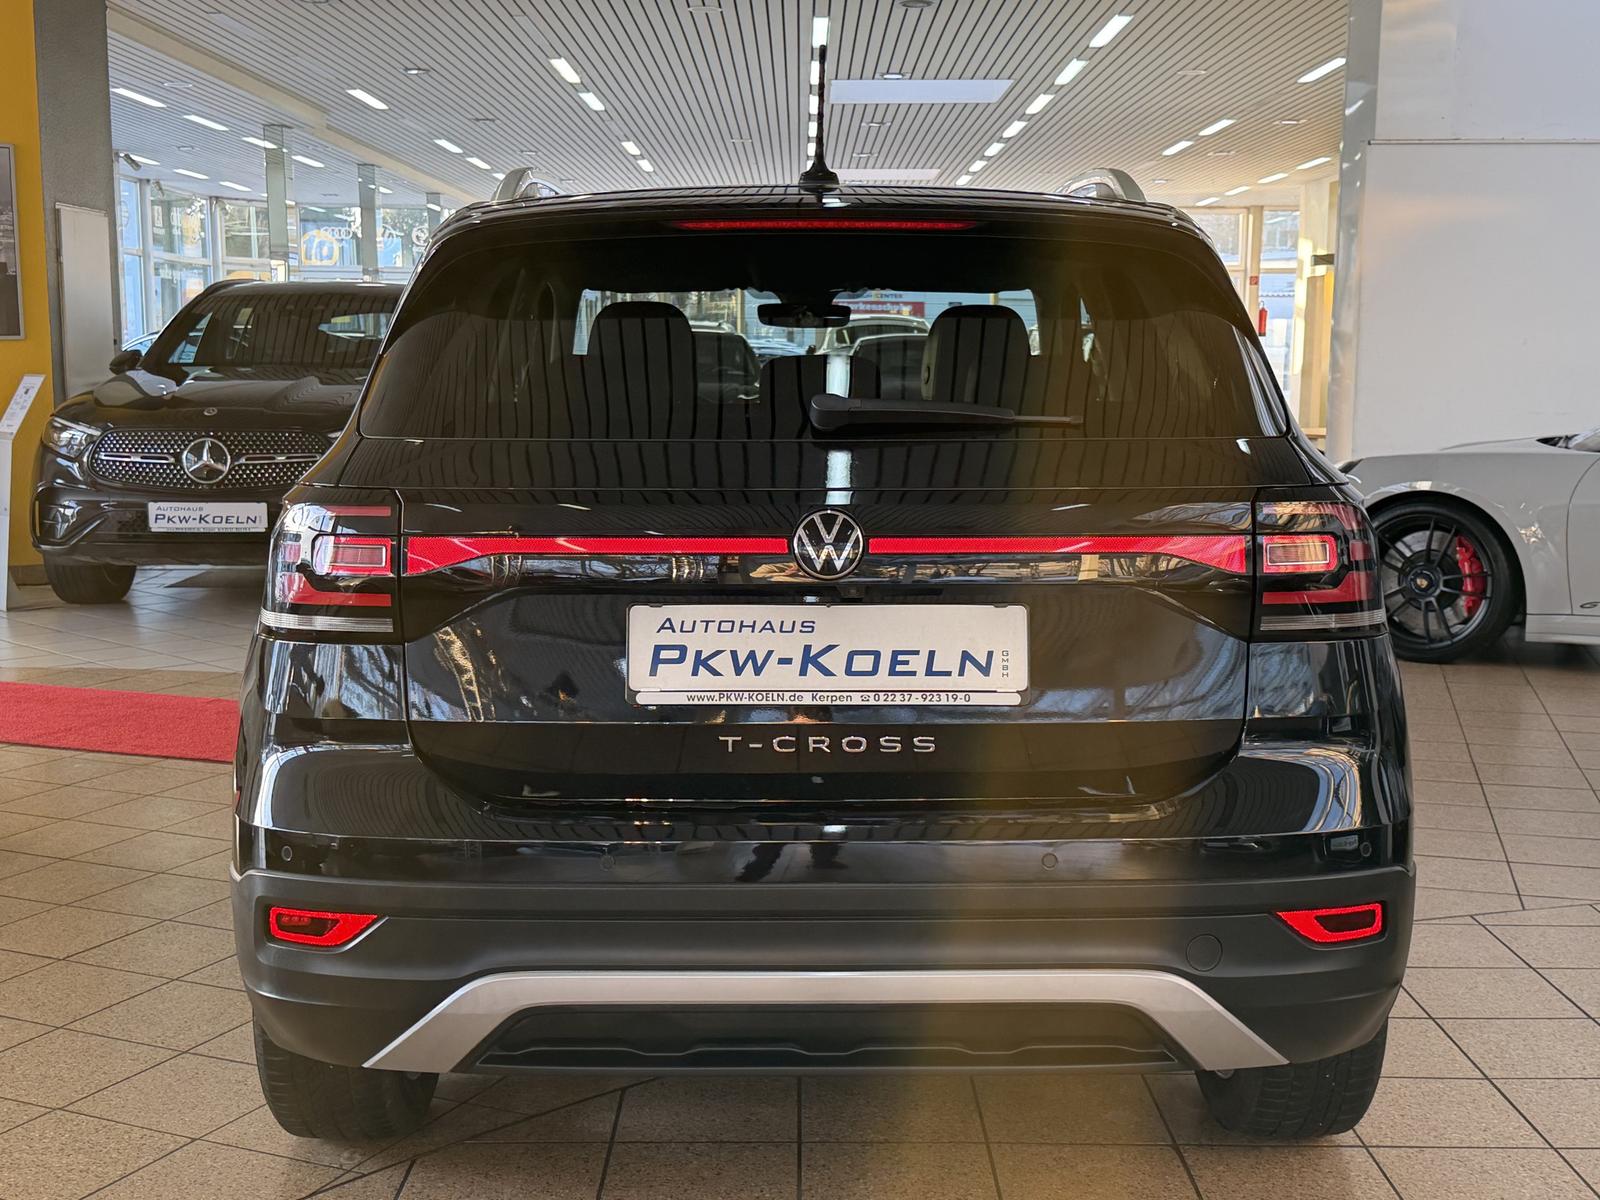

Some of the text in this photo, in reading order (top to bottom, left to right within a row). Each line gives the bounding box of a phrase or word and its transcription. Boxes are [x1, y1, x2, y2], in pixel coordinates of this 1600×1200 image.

[154, 513, 258, 525] PKW-KOELN
[656, 617, 816, 634] AUTOHAUS
[648, 644, 994, 677] PKW-KOELN
[1001, 650, 1009, 678] GMBH
[686, 692, 804, 702] www.PKW-KOELN.de
[811, 692, 853, 704] Kerpen
[718, 735, 937, 753] T-CROSS
